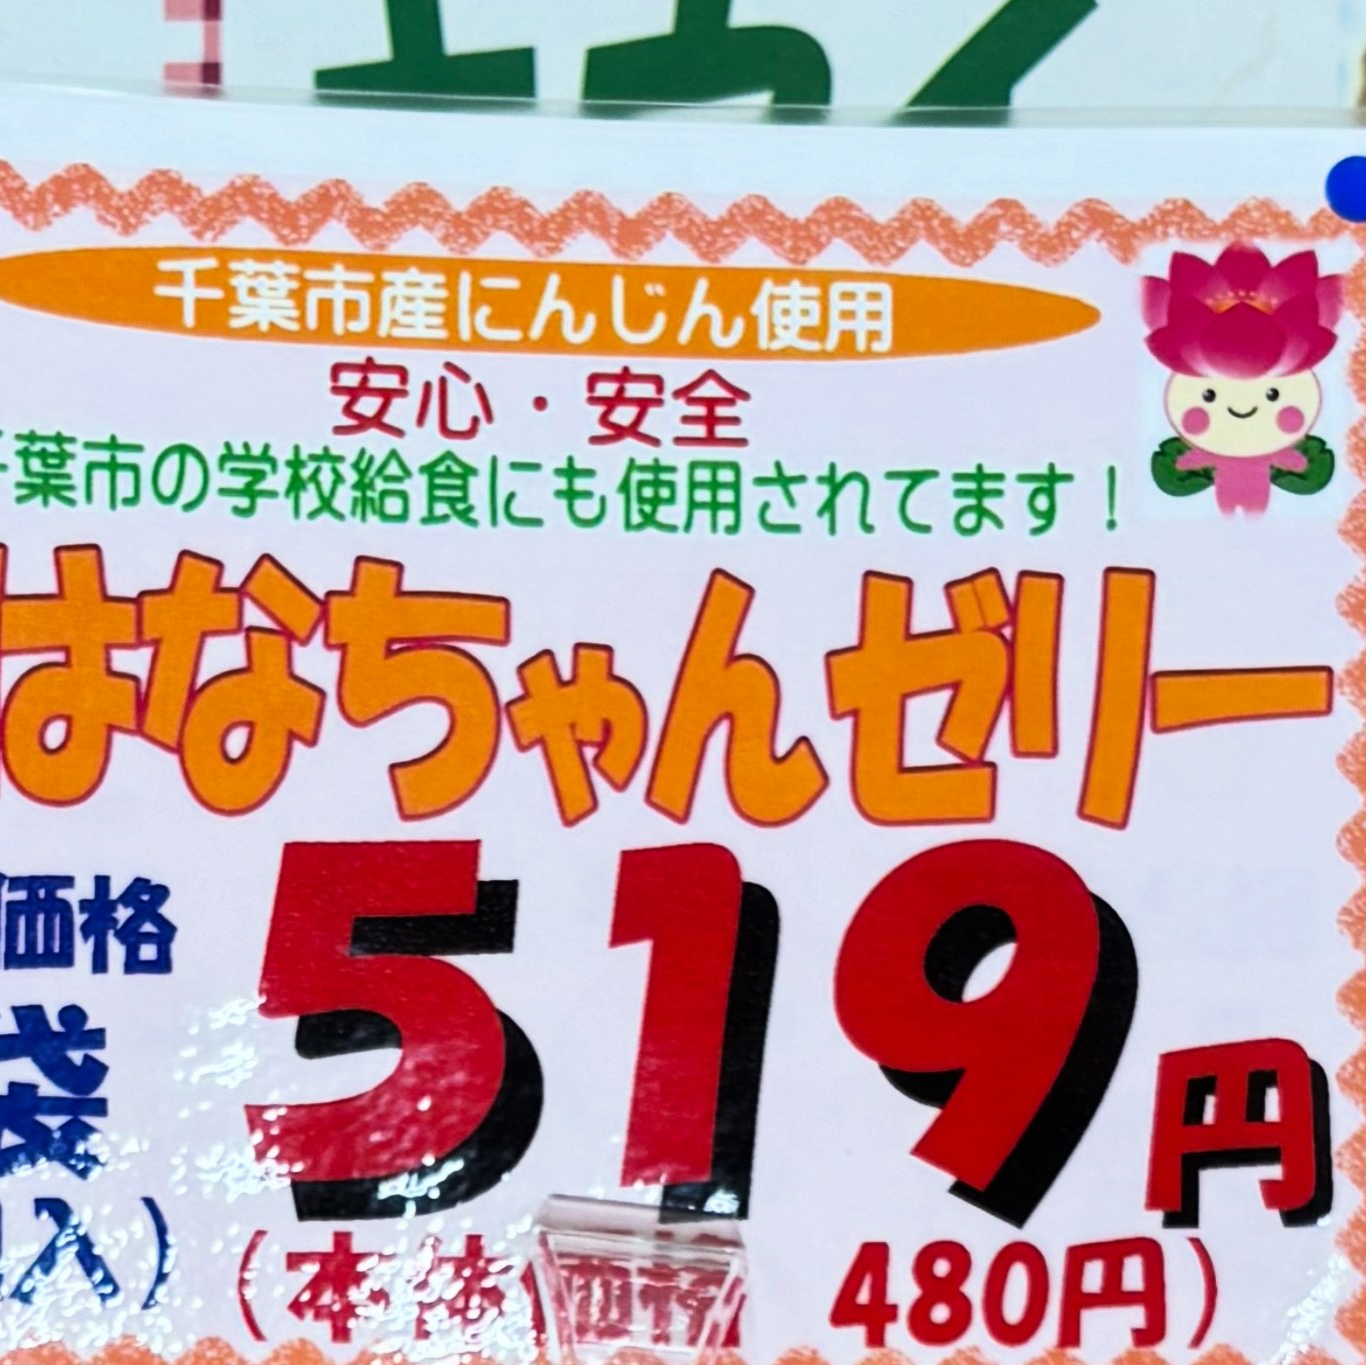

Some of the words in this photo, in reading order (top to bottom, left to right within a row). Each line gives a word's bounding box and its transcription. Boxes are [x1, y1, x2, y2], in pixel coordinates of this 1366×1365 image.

[152, 256, 894, 357] 千葉市産にんじん使用
[328, 354, 753, 450] 安心・安全
[242, 837, 1334, 1230] 519円
[828, 1234, 1217, 1350] 480円)
